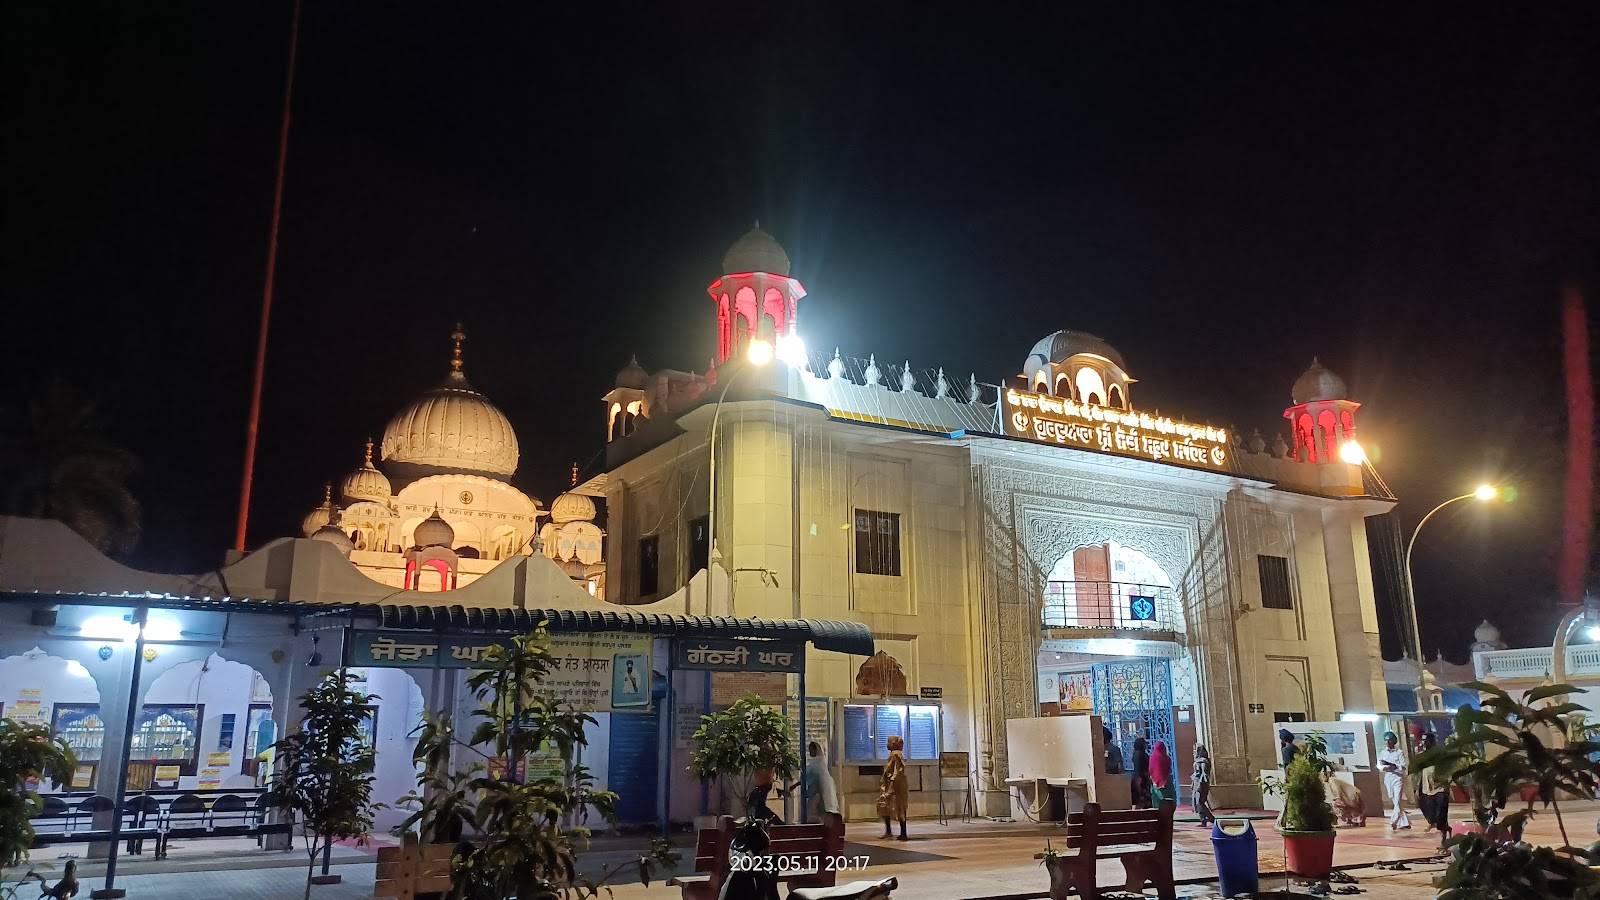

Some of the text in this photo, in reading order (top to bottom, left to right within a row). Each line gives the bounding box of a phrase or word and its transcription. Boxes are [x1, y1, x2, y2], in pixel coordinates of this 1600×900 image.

[1033, 416, 1208, 463] ਗੁਰਦੁਆਰਾ ਸ੍ਰੀ ਜੋਤੀ ਸਰੂਪ ਸਾਹਿਬ
[371, 636, 438, 661] ਜੋੜਾ
[687, 645, 793, 666] ਗੱਠੜੀ ਘਰ
[565, 653, 579, 671] ਸੰਤ
[582, 657, 609, 672] ਖ਼ਾਲਸਾ
